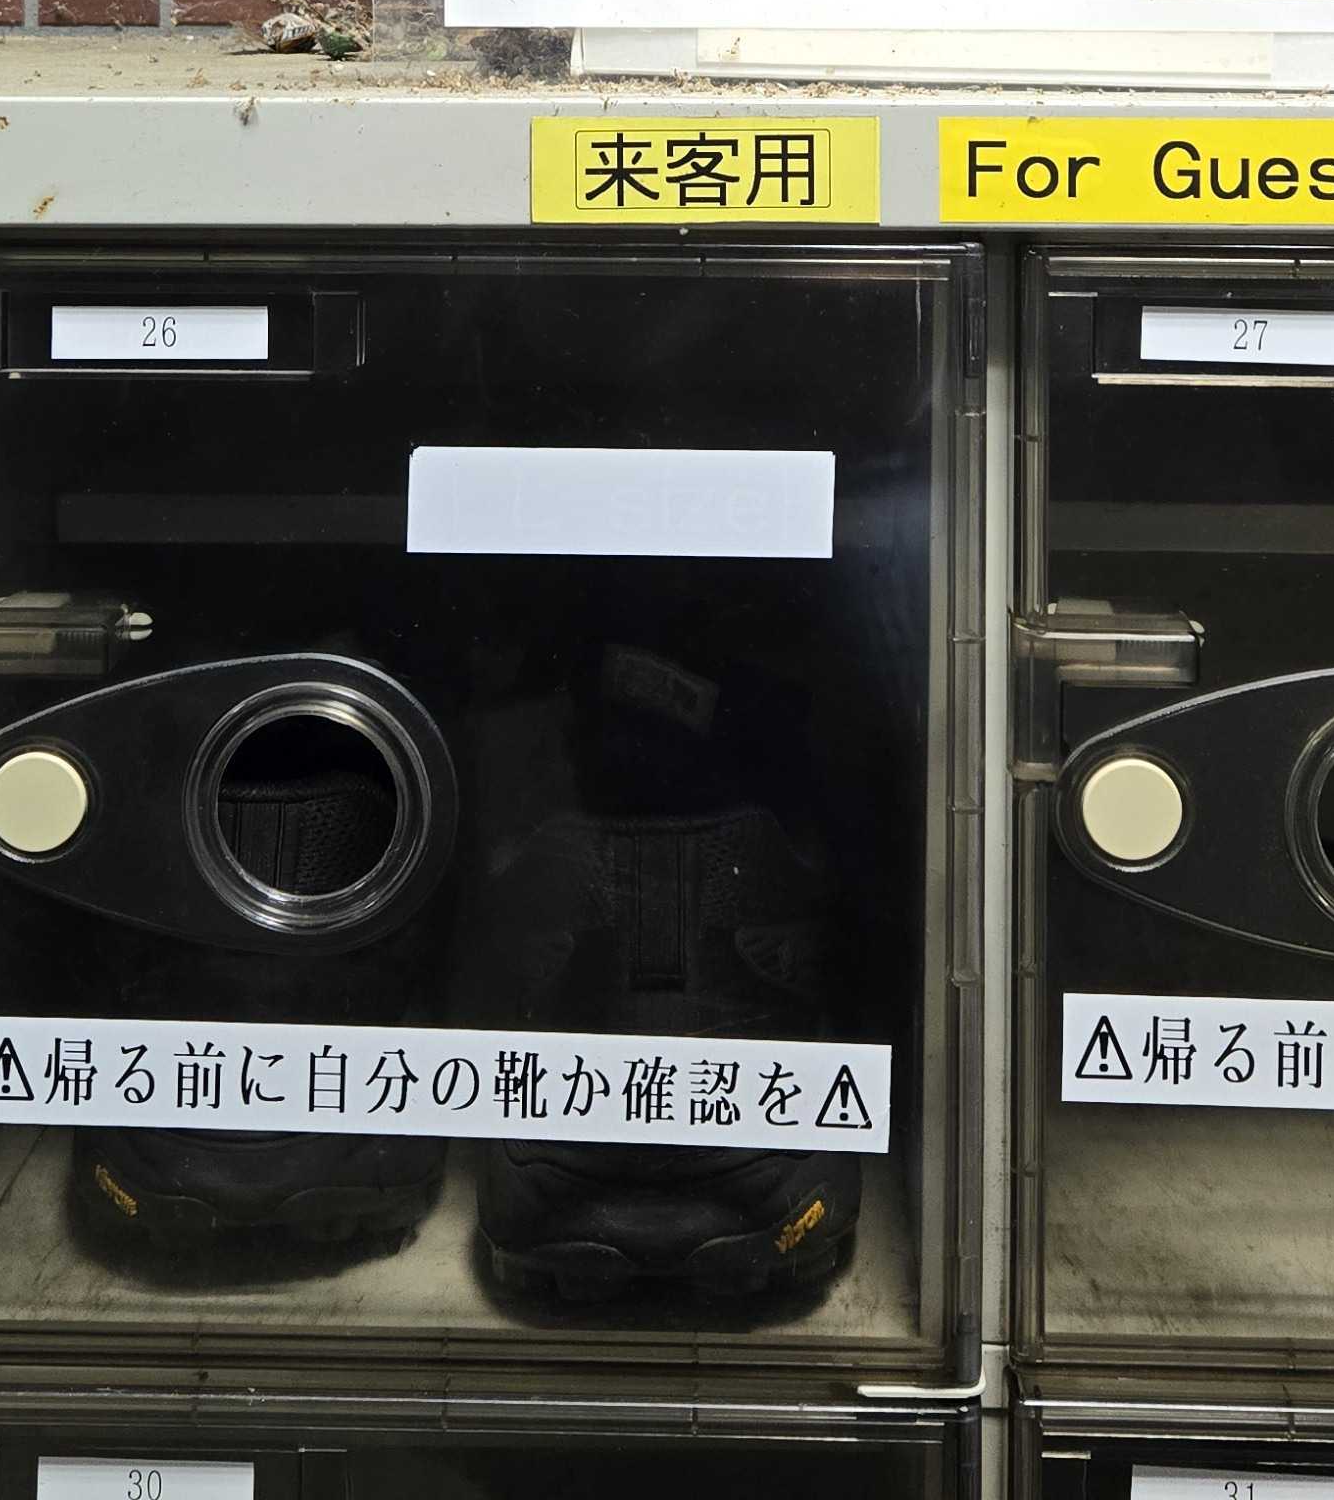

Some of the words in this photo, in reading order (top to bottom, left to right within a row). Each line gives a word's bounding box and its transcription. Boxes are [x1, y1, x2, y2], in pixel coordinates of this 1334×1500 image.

[586, 132, 814, 206] 来客用
[969, 141, 1099, 198] For
[143, 317, 176, 347] 26
[1234, 319, 1267, 350] 27
[44, 1037, 802, 1126] 帰る前に自分の靴か確認を
[129, 1470, 161, 1500] 30
